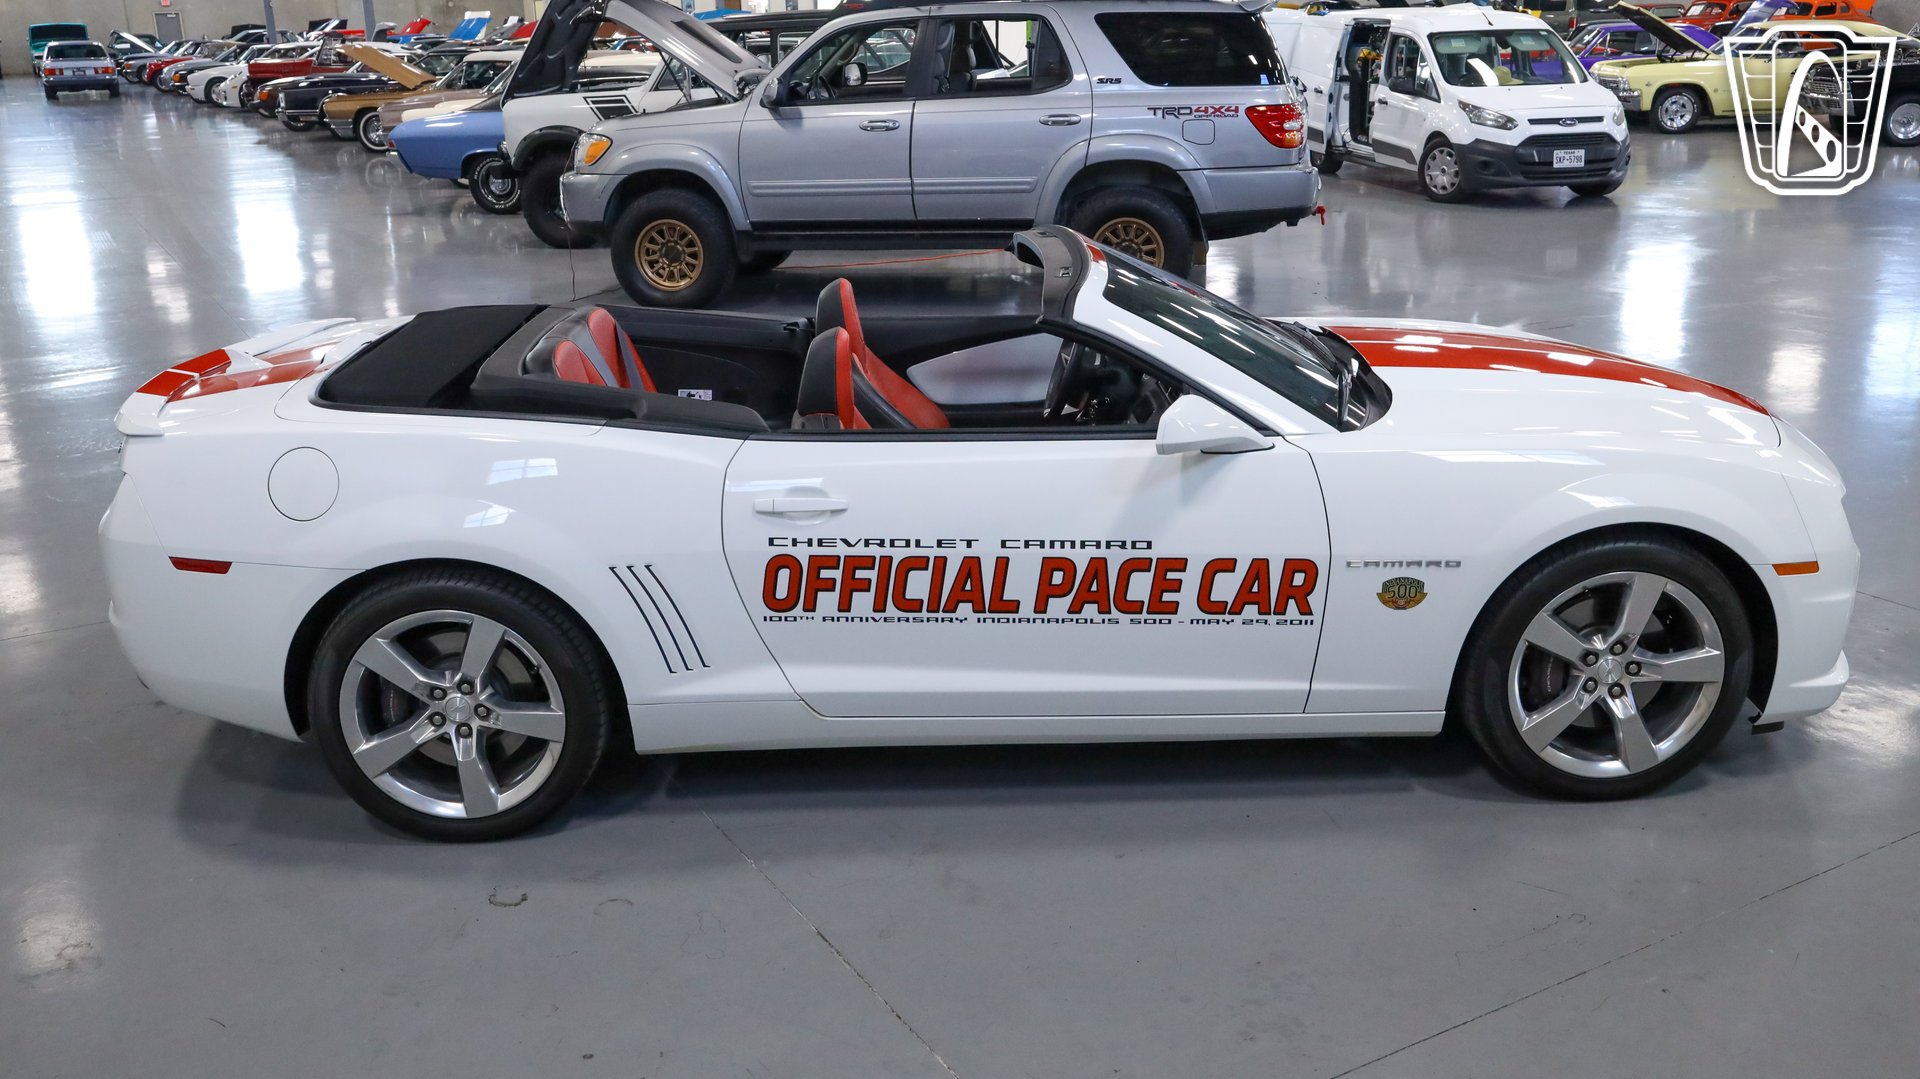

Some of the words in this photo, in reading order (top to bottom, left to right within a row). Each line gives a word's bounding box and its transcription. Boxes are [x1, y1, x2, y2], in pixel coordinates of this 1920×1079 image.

[768, 537, 980, 549] CHEVROLET
[1000, 539, 1153, 550] CAMARO
[1345, 559, 1462, 568] CAMARO
[762, 553, 1021, 614] OFFICIAL
[1033, 556, 1189, 615] PACE
[1196, 557, 1319, 616] CAR
[1387, 583, 1418, 599] 500
[763, 615, 815, 623] 100TH
[822, 616, 968, 624] ANNIVERSARY
[977, 617, 1120, 625] INDIANAPOLIS
[1190, 618, 1235, 626] MAY
